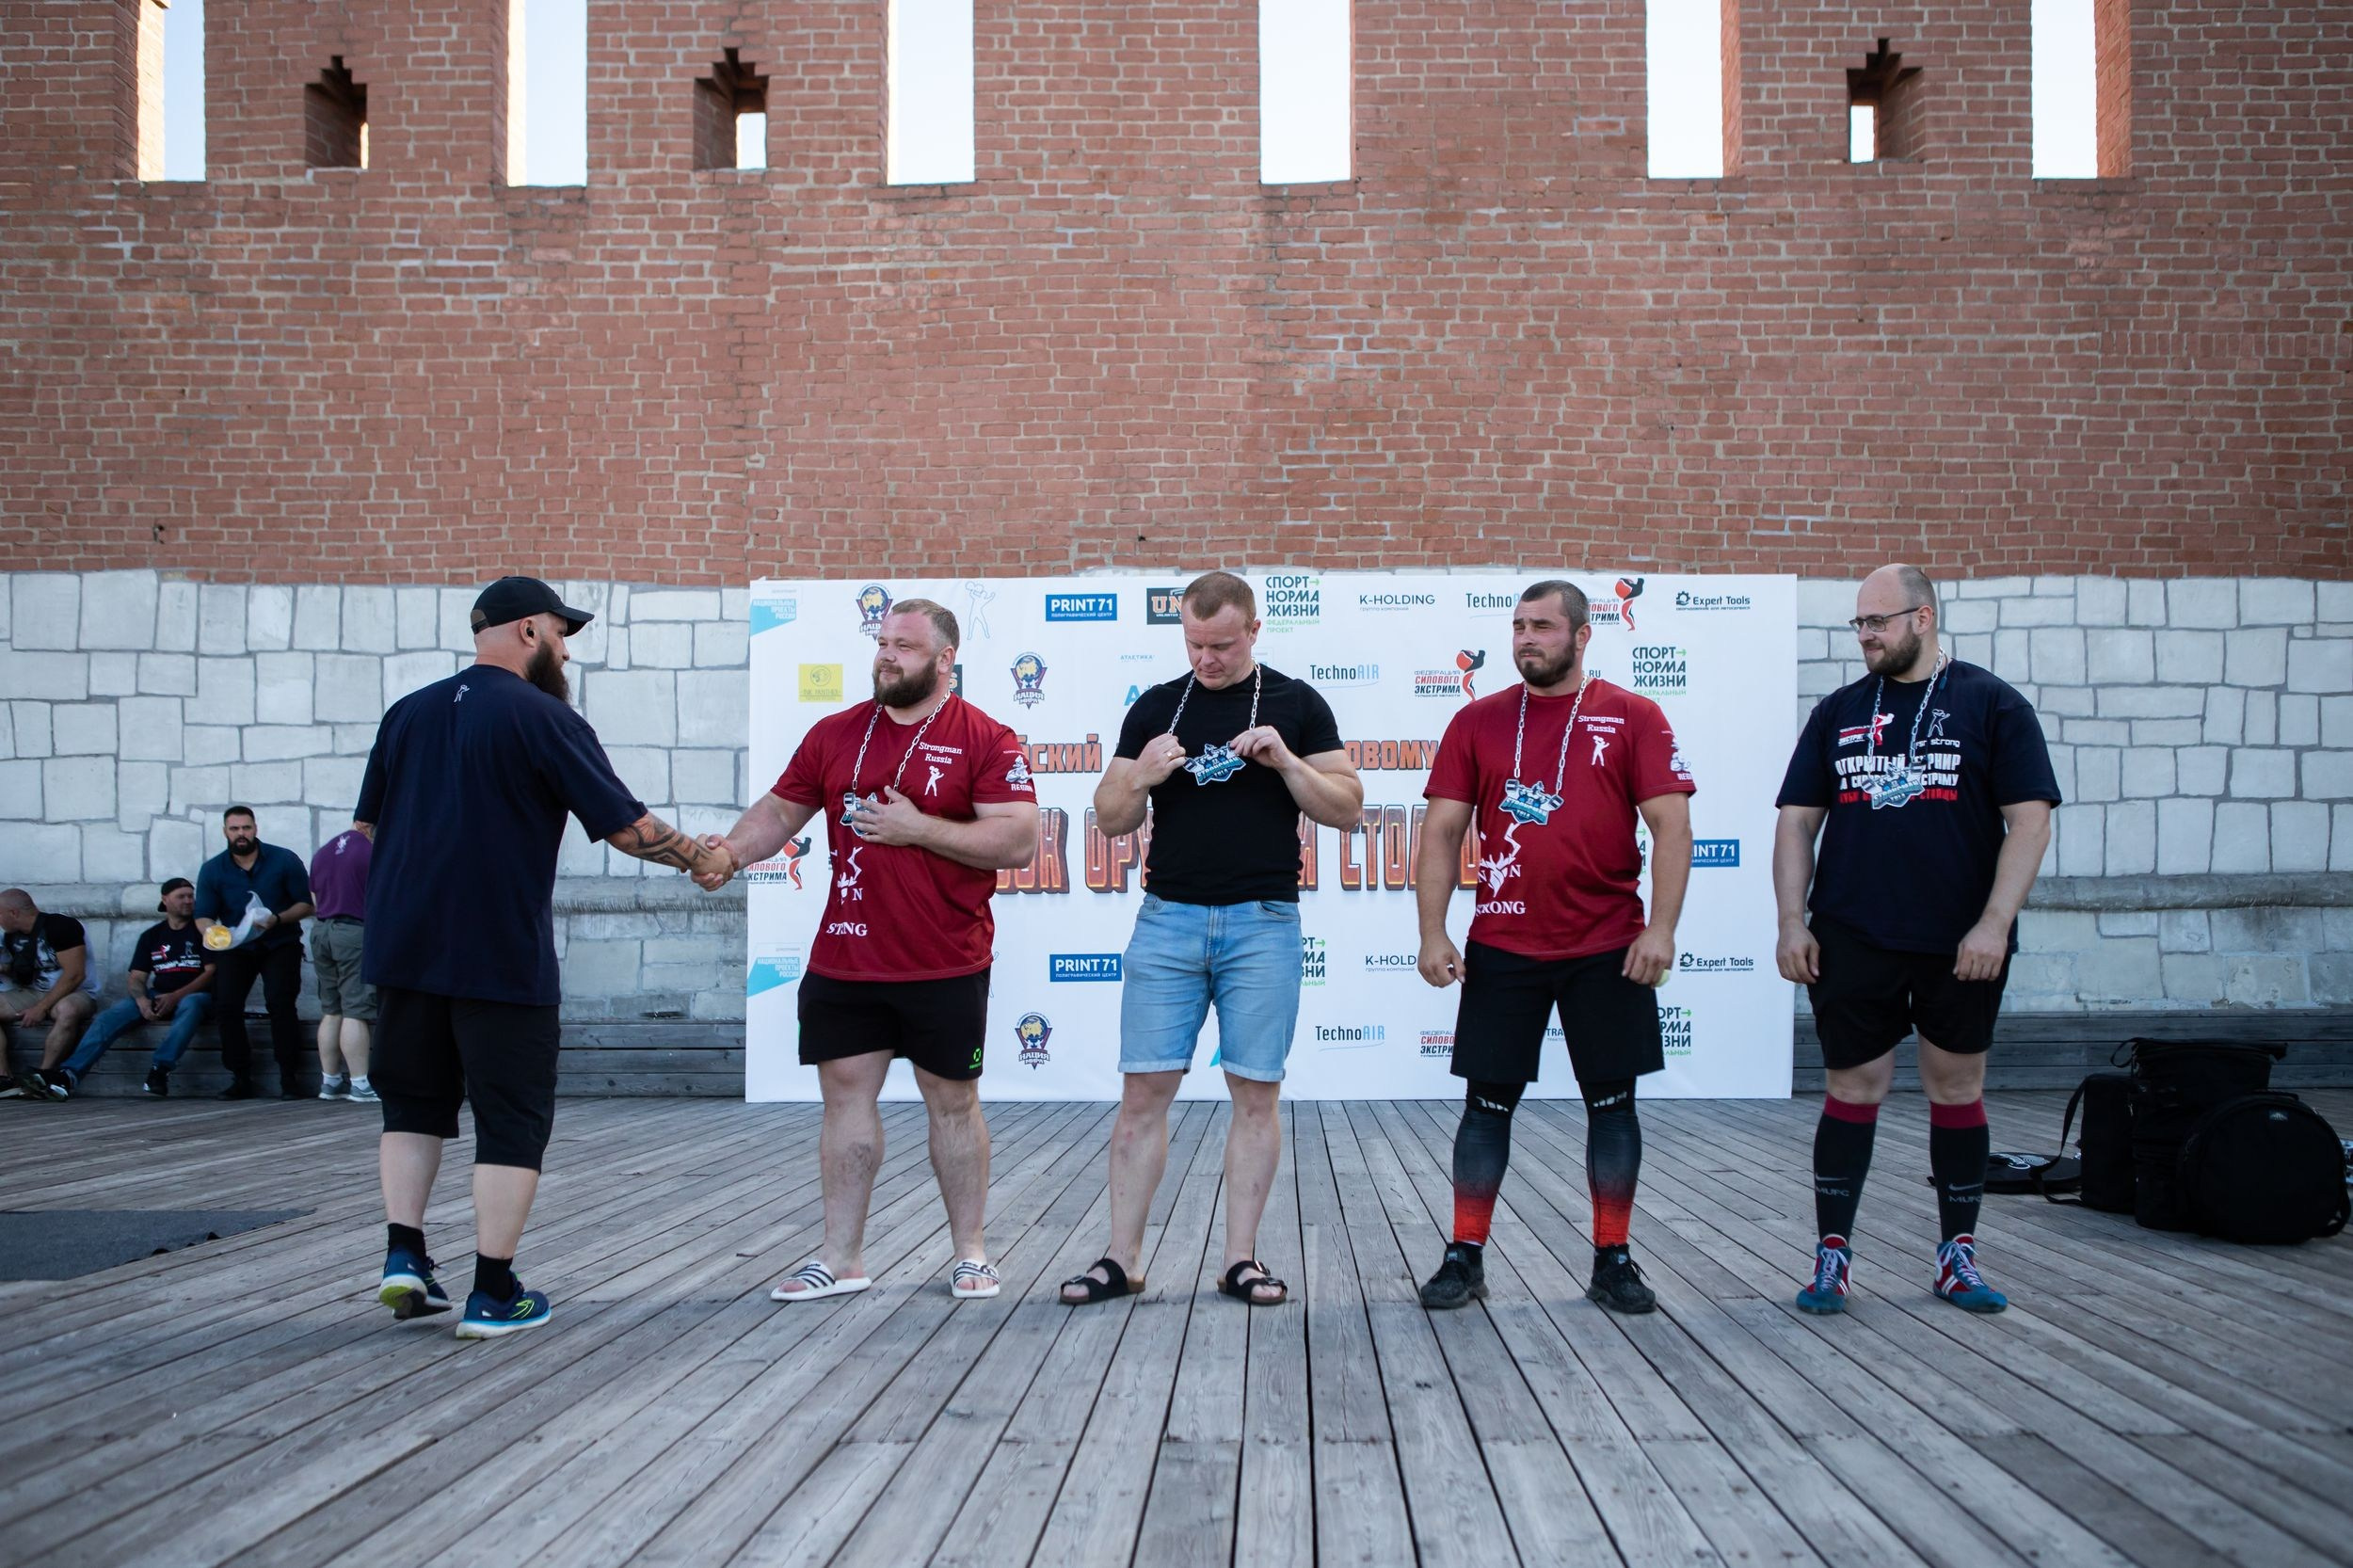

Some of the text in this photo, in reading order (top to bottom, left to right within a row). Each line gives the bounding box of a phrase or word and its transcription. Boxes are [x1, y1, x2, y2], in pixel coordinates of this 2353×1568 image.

[1266, 576, 1309, 588] СПОРТ
[1266, 590, 1320, 602] НОРМА
[1359, 595, 1435, 605] K-HOLDING
[1693, 596, 1751, 607] Expert Tools
[1050, 598, 1113, 612] PRINT 71
[1267, 604, 1320, 616] ЖИЗНИ
[1591, 613, 1620, 622] ТРИМА
[1632, 648, 1676, 659] СПОРТ
[1310, 664, 1379, 680] TechnoAIR
[1633, 661, 1686, 673] НОРМА
[1415, 676, 1459, 684] СИЛОВОГО
[1634, 675, 1686, 687] ЖИЗНИ
[1415, 685, 1460, 694] ЭКСТРИМА
[1578, 715, 1625, 724] Strongman
[1587, 724, 1616, 733] Russia
[919, 742, 962, 754] Strongman
[924, 754, 952, 764] Russia
[1691, 844, 1735, 857] INT 71
[748, 872, 787, 881] КСТРИМА
[1055, 958, 1117, 972] PRINT 71
[1365, 954, 1417, 966] K-HOLD
[1697, 956, 1754, 968] Expert Tools
[1657, 1007, 1681, 1019] ОРТ
[1316, 1025, 1385, 1041] TechnoAIR
[1659, 1021, 1691, 1033] РМА
[1420, 1036, 1455, 1045] СИЛОВО
[1662, 1035, 1691, 1048] ЗНИ
[1420, 1045, 1454, 1054] ЭКСТРИ
